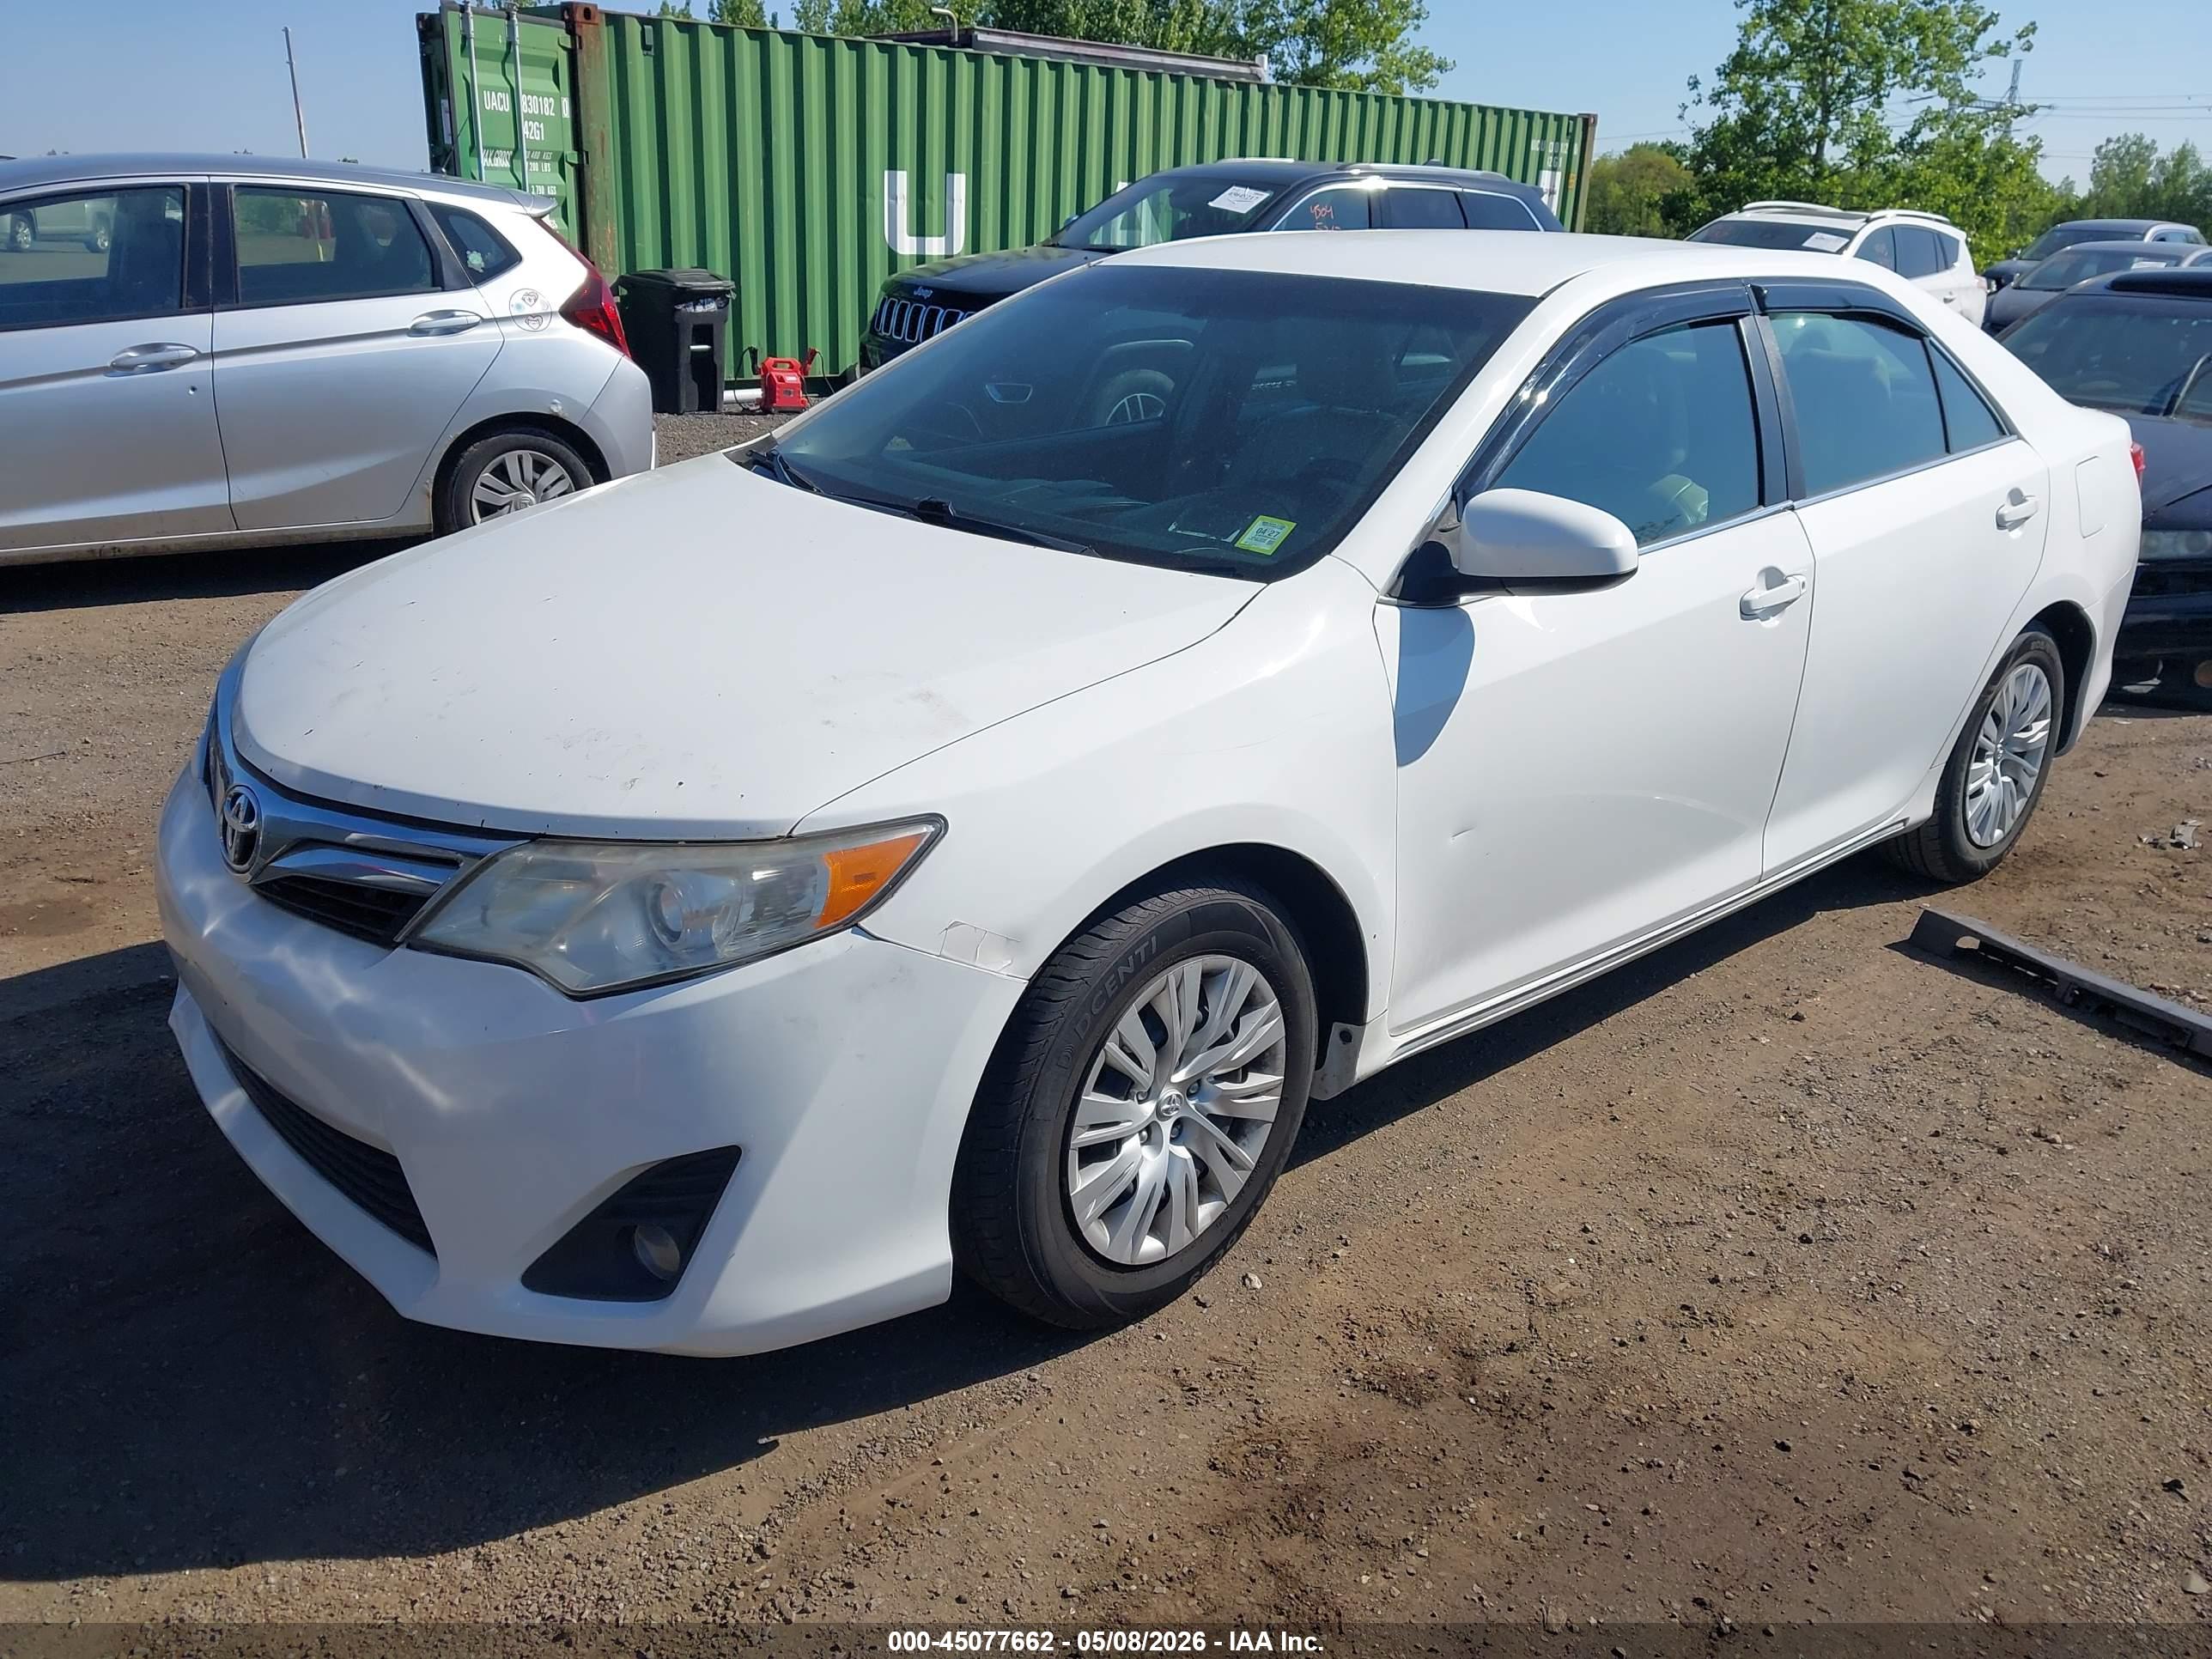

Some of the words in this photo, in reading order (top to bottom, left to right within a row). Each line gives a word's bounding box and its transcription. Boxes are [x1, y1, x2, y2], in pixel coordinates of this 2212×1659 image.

[483, 90, 509, 112] UACU
[522, 94, 555, 116] 830182
[523, 120, 544, 140] 42G1
[884, 170, 966, 255] U
